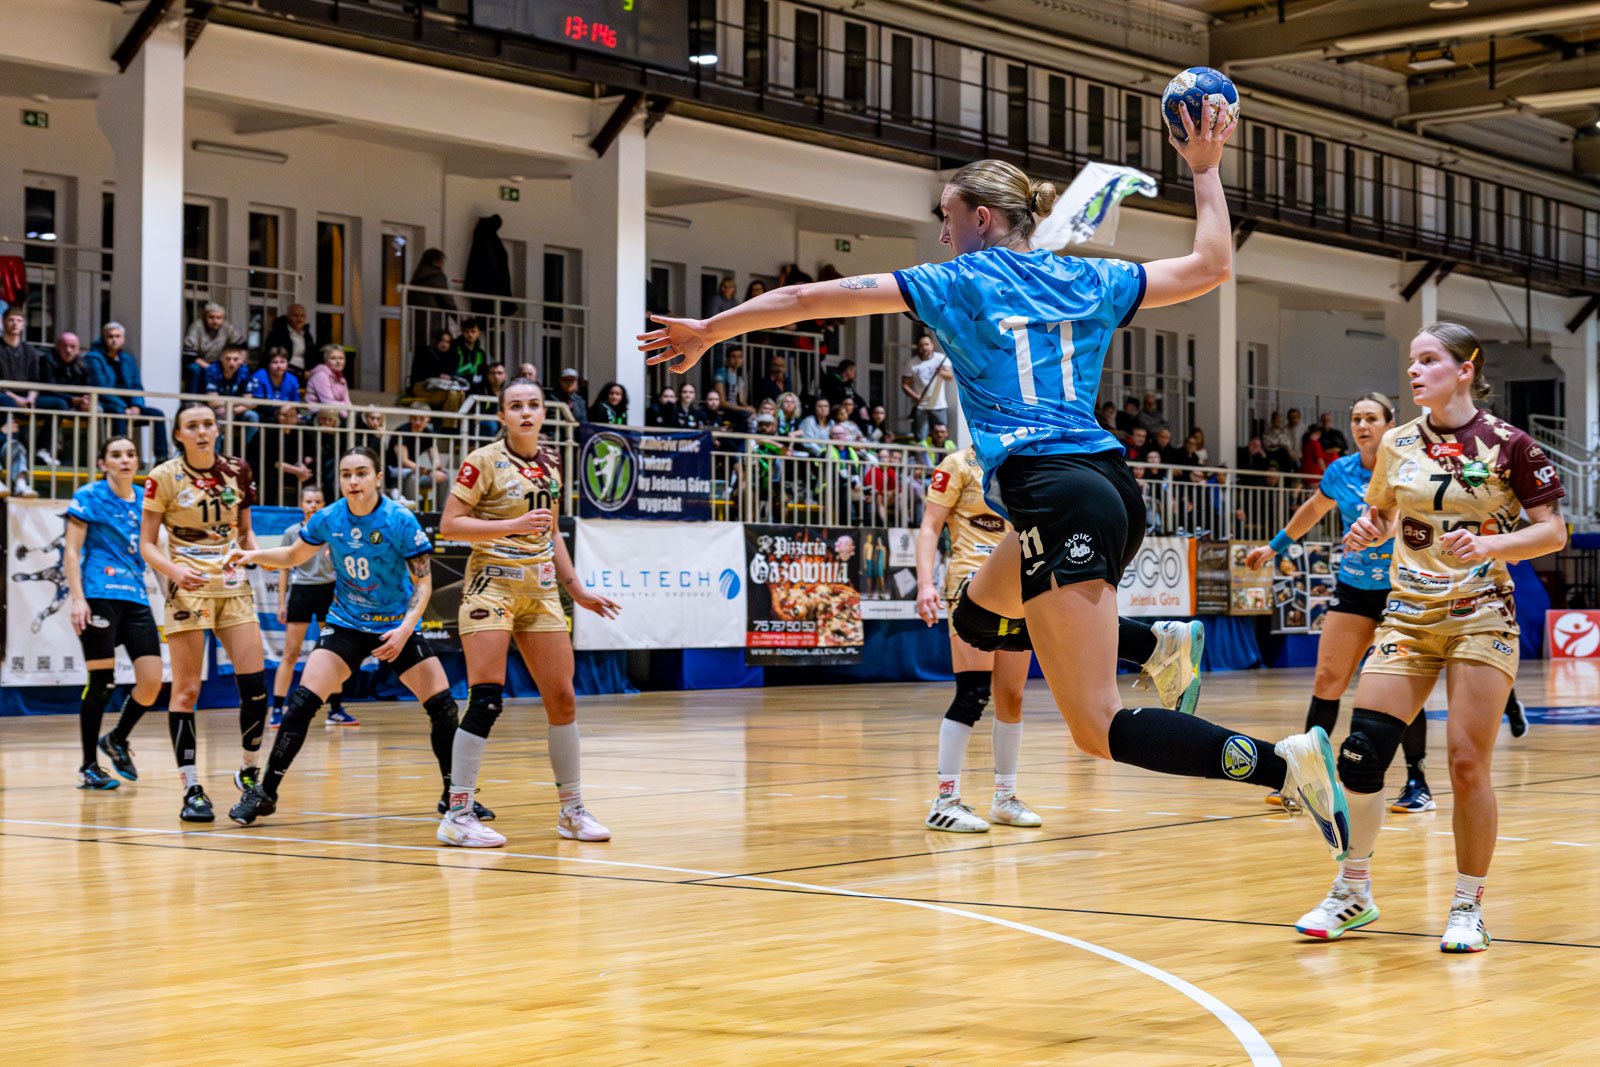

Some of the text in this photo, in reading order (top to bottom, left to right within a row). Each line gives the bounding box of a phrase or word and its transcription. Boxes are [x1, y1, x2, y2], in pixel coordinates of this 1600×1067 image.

[998, 315, 1078, 405] 11
[652, 475, 686, 492] Jelenia
[688, 476, 711, 493] Góra
[1430, 473, 1452, 511] 7
[197, 498, 222, 523] 11
[773, 535, 827, 559] Pizzeria
[1019, 526, 1044, 559] 11
[344, 555, 370, 580] 88
[585, 571, 711, 587] JELTECH
[750, 553, 850, 584] Gazownia
